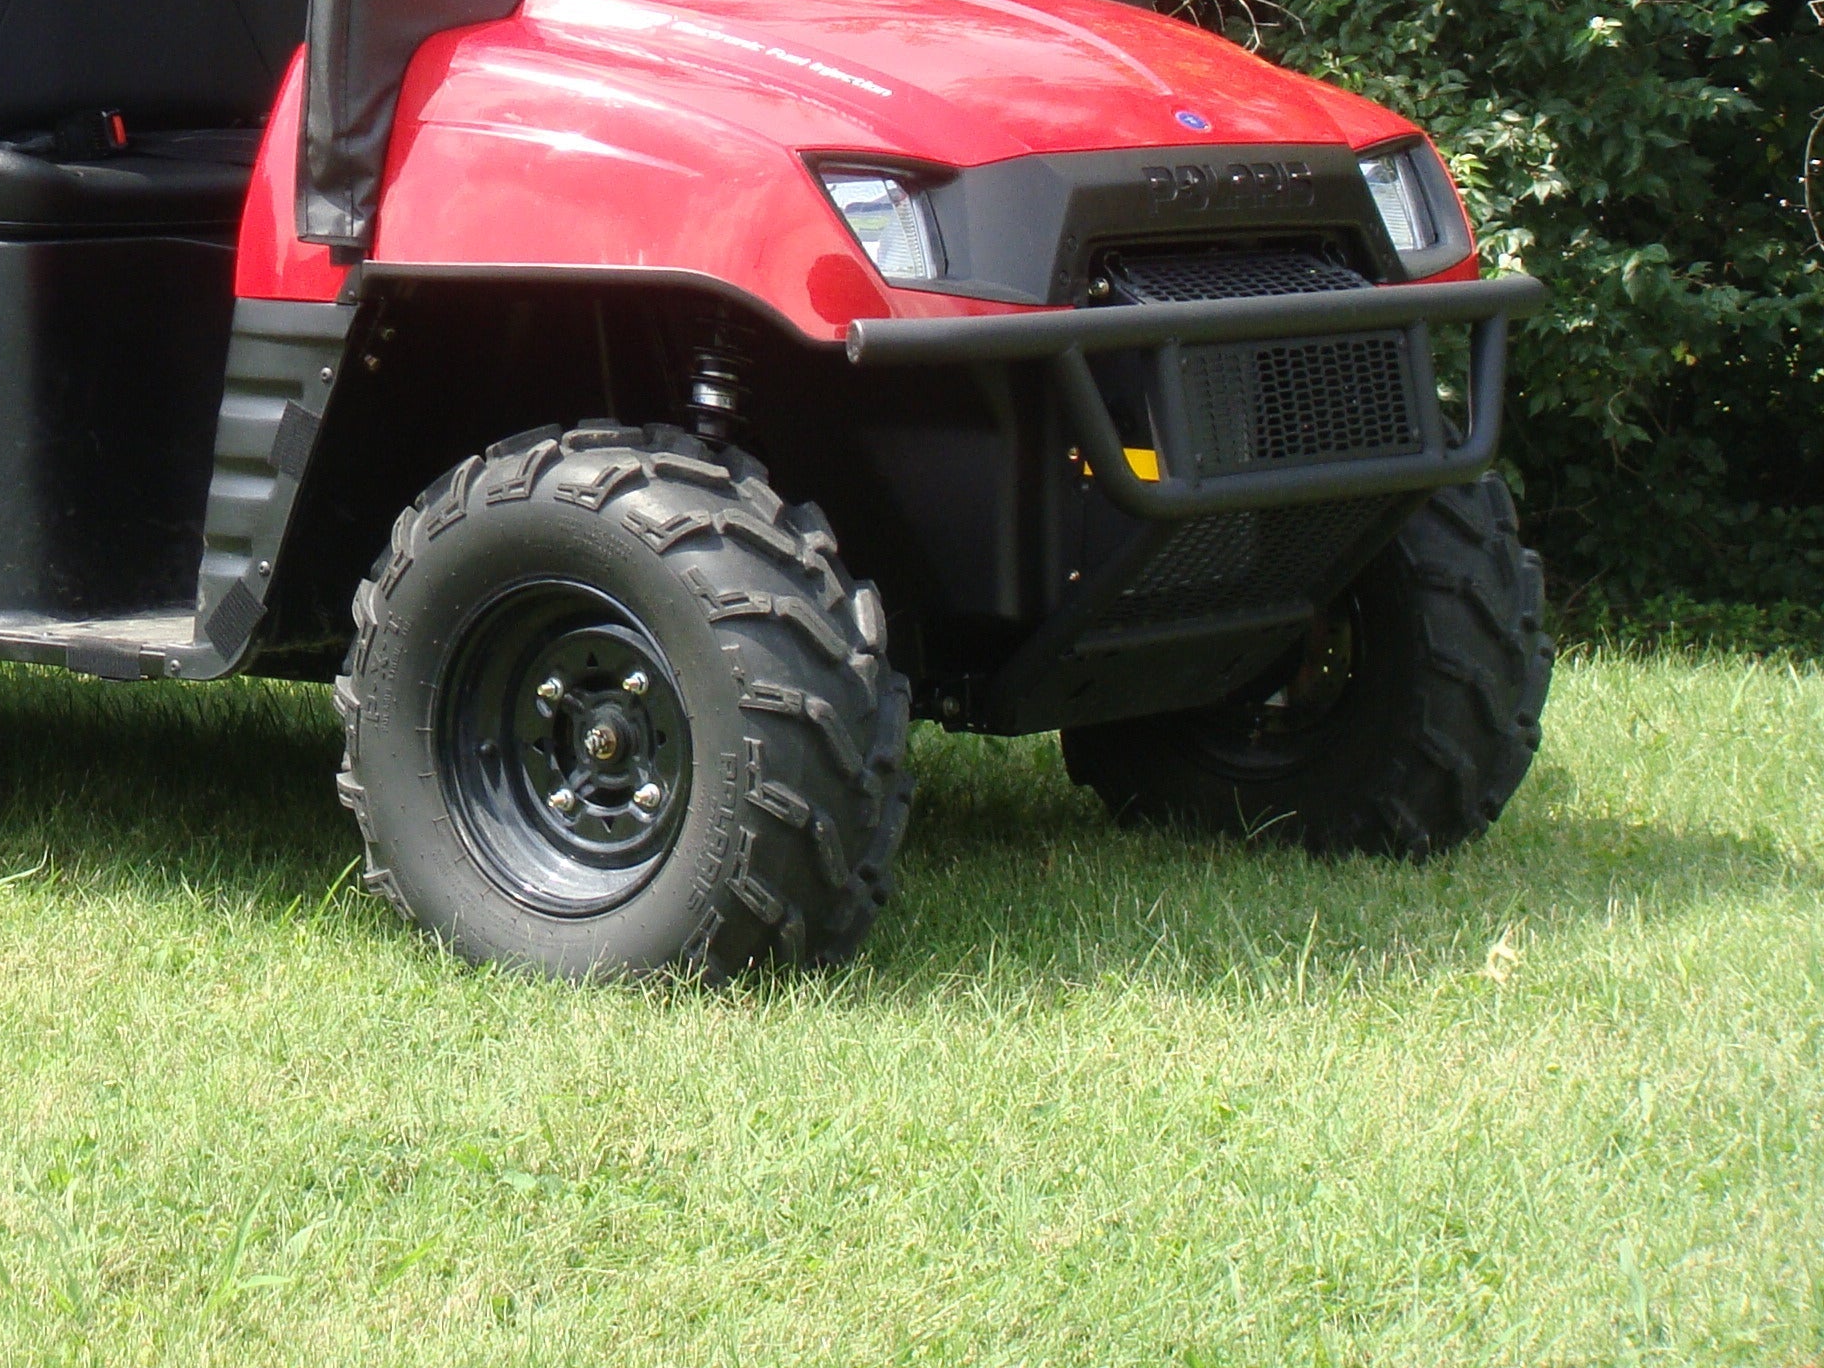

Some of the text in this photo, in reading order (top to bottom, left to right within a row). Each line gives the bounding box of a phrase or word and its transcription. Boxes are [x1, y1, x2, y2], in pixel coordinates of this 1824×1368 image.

[765, 47, 812, 67] Fuel
[808, 62, 894, 98] Injection
[1141, 160, 1315, 214] POLARIS
